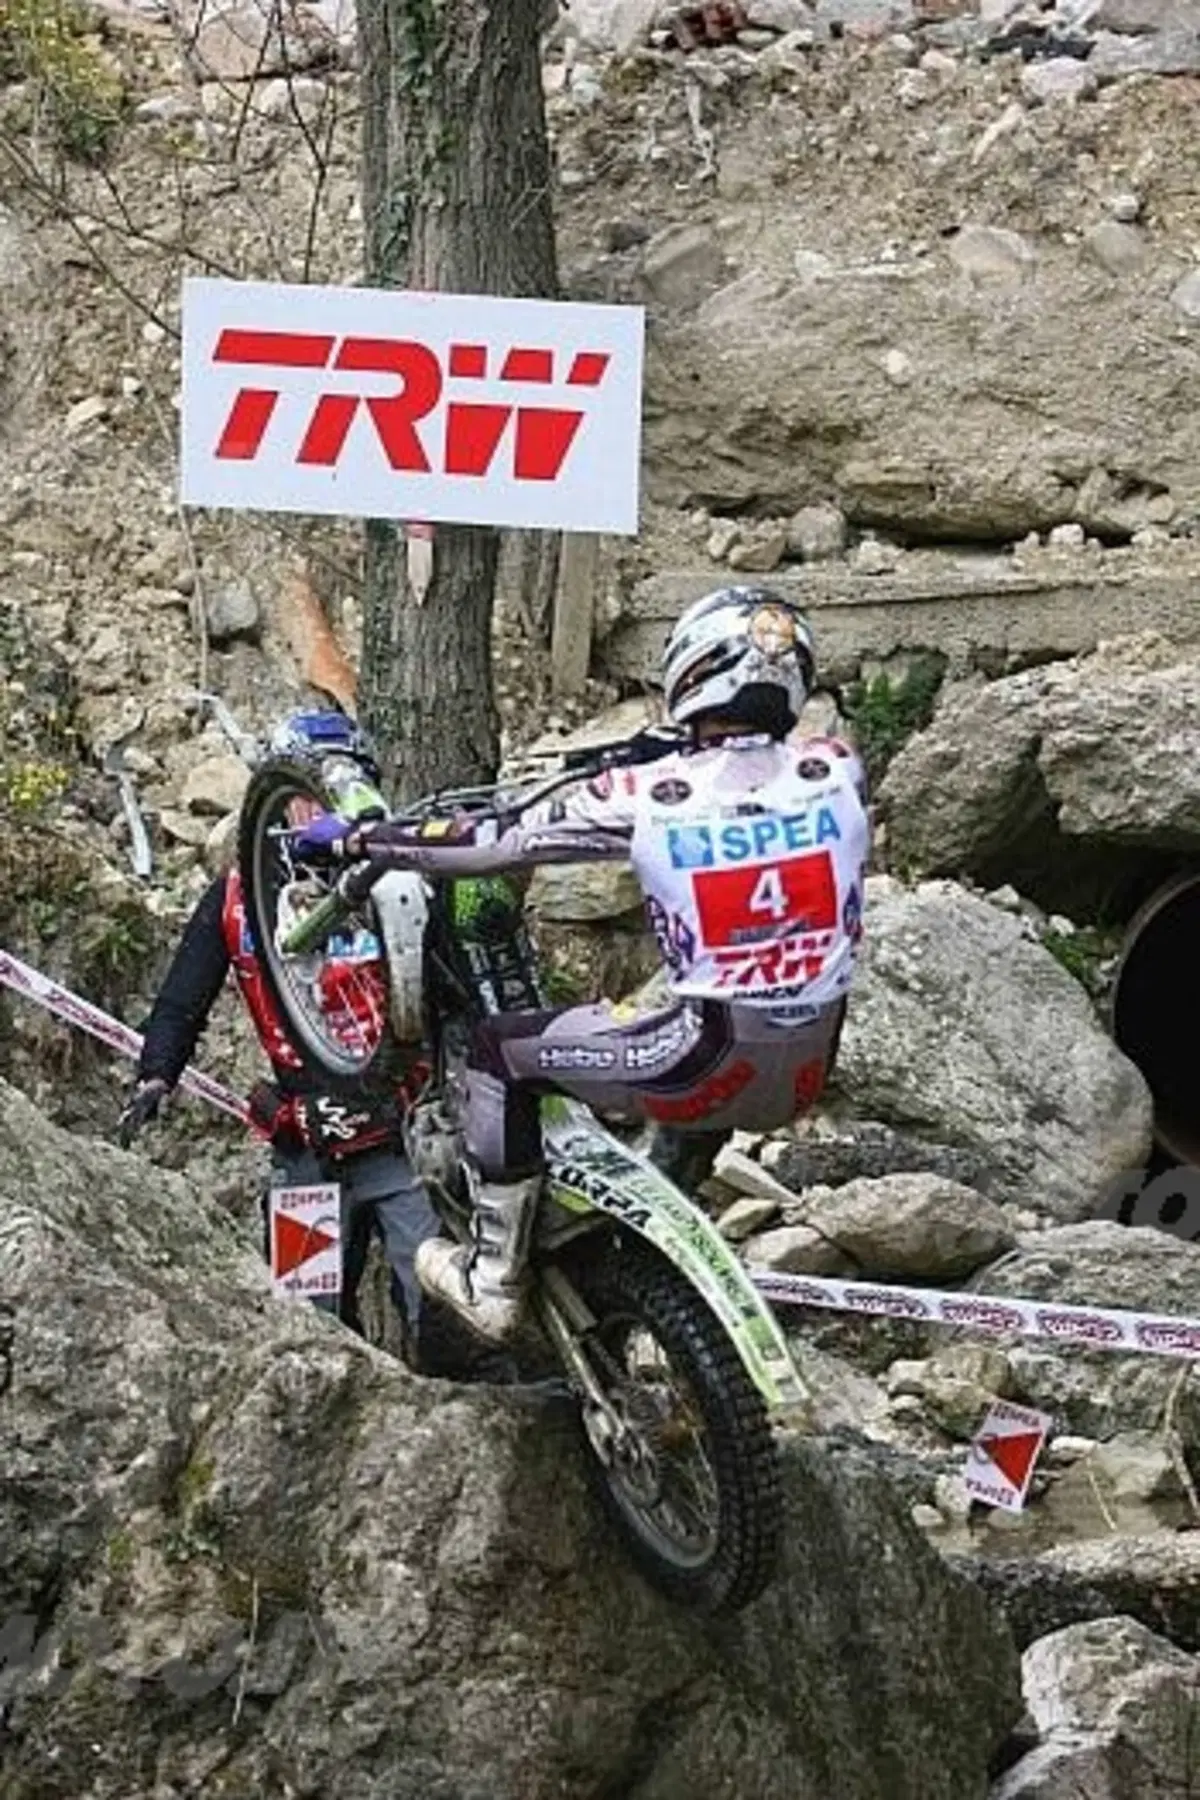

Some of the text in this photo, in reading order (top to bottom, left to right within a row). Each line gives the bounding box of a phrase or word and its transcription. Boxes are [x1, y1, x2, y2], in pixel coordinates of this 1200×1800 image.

[212, 328, 611, 482] TRW
[719, 806, 841, 860] SPEA
[748, 868, 789, 919] 4
[712, 933, 832, 988] TRW
